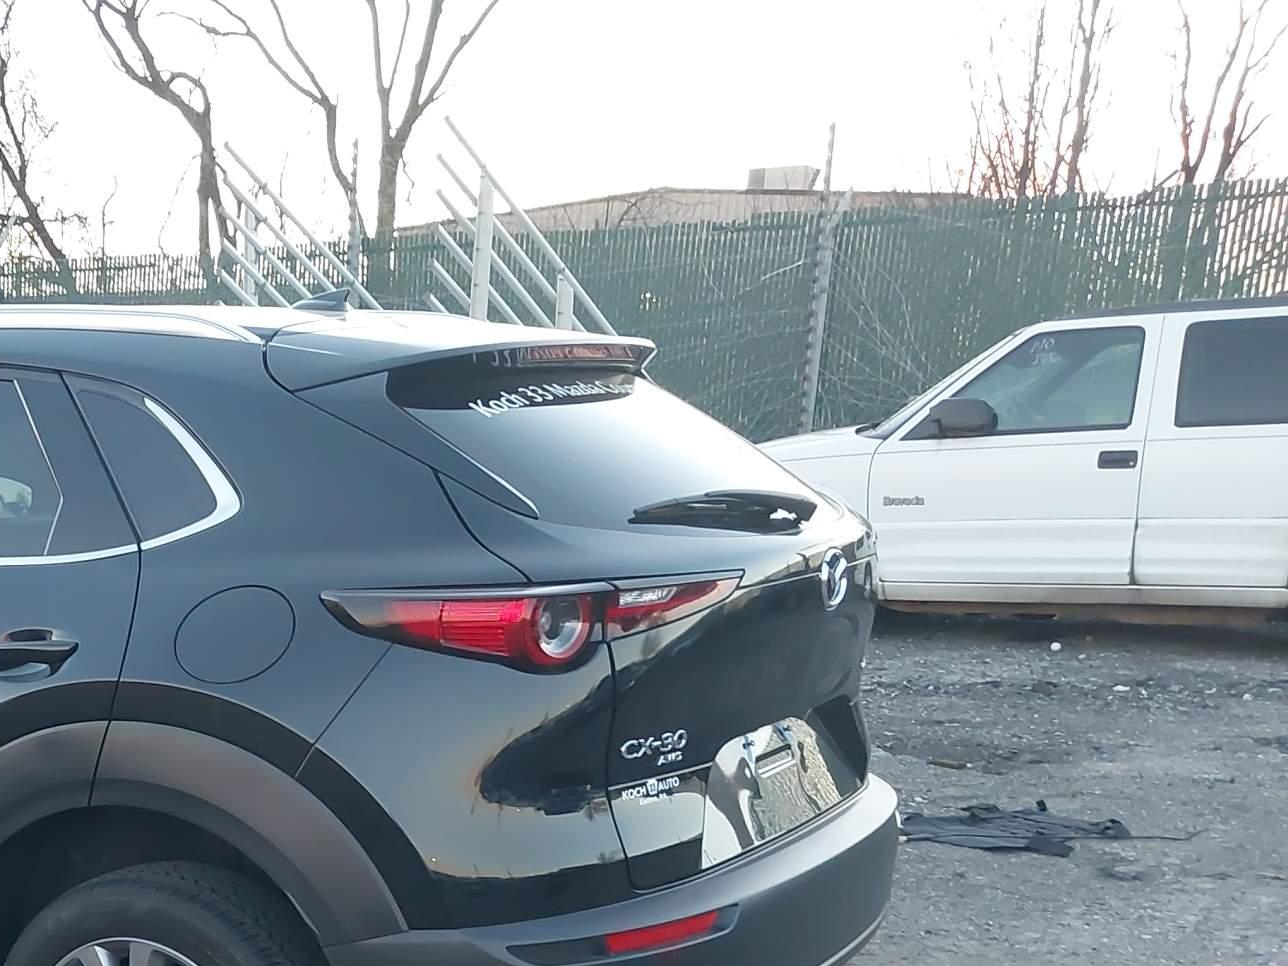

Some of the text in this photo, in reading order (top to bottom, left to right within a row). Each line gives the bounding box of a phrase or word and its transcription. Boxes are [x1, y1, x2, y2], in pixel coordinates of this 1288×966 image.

[468, 391, 530, 418] Koch
[518, 383, 555, 403] 33
[620, 729, 687, 759] CX-30
[622, 786, 646, 801] KOCH
[659, 777, 679, 791] AUTO
